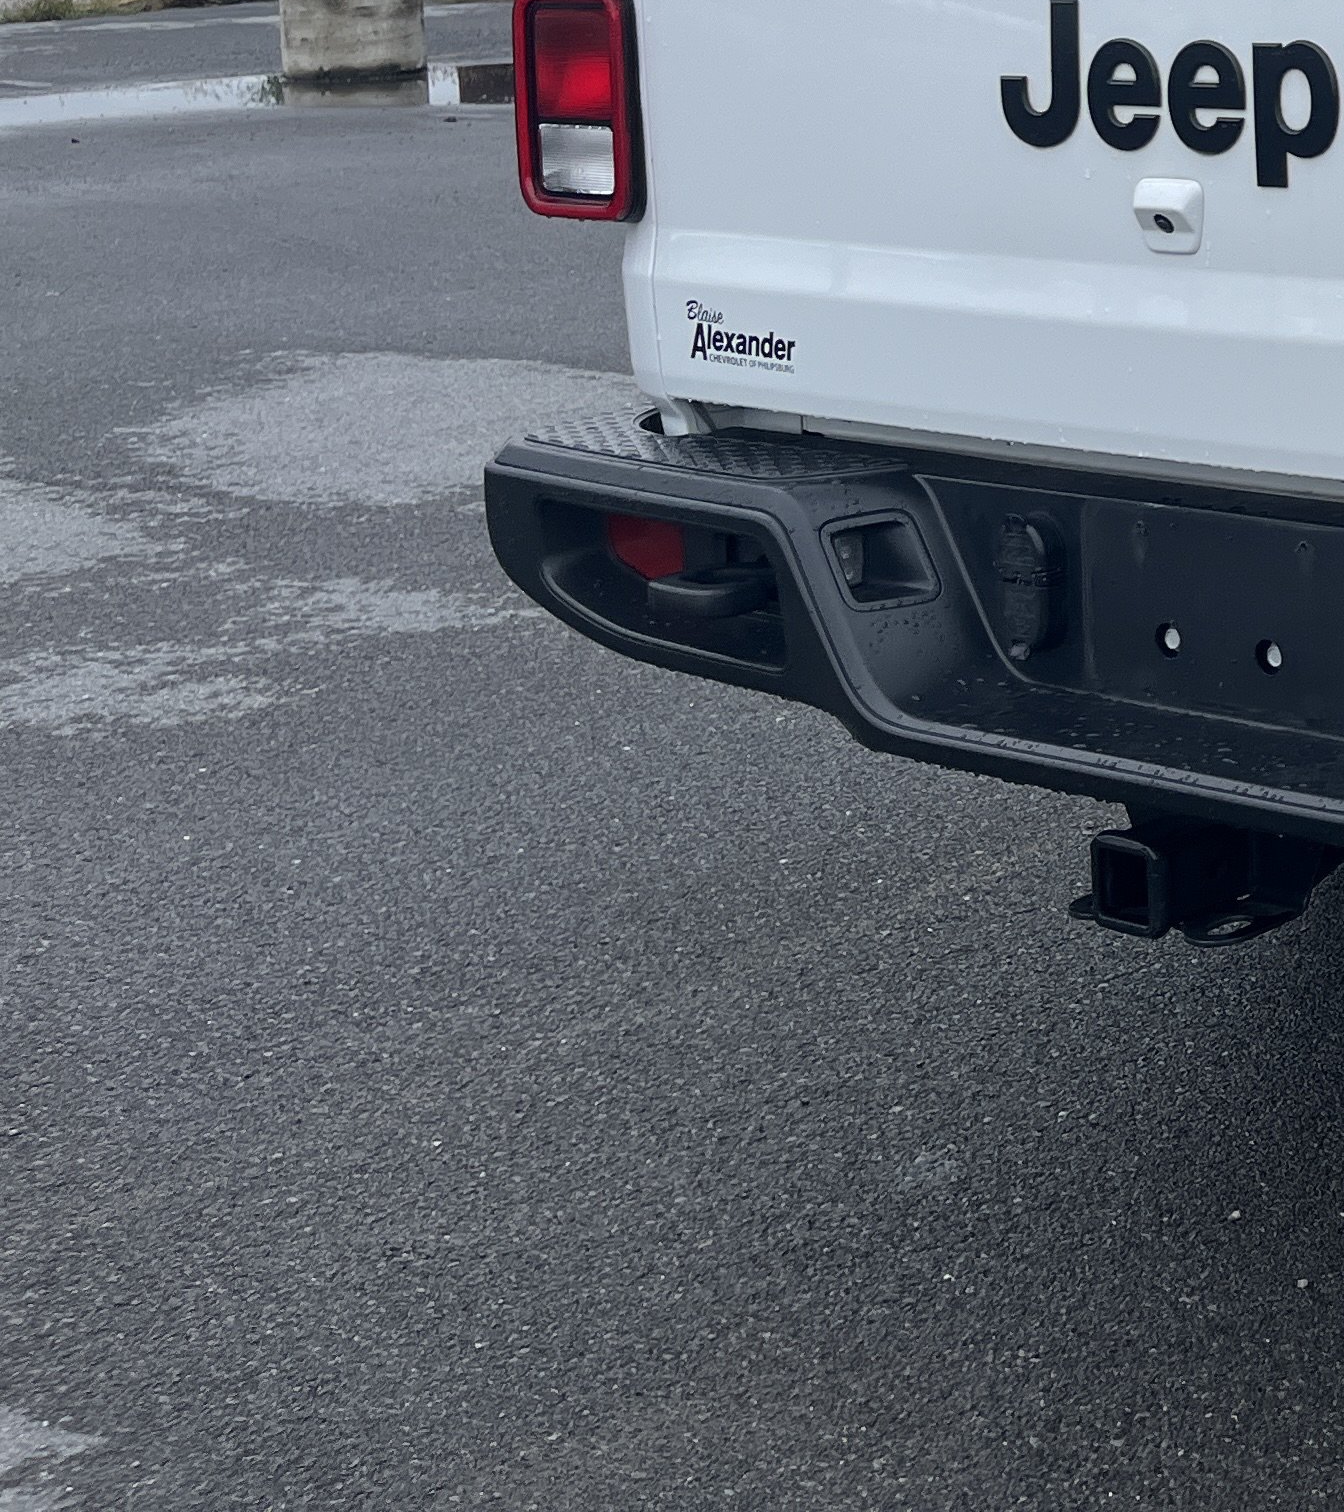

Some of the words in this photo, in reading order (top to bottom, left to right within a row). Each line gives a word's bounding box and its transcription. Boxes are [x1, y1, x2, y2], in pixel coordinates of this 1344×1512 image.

[1000, 0, 1340, 188] Jeep
[686, 299, 724, 325] Blaise
[690, 322, 796, 362] Alexander
[709, 353, 748, 367] CHEVROLET
